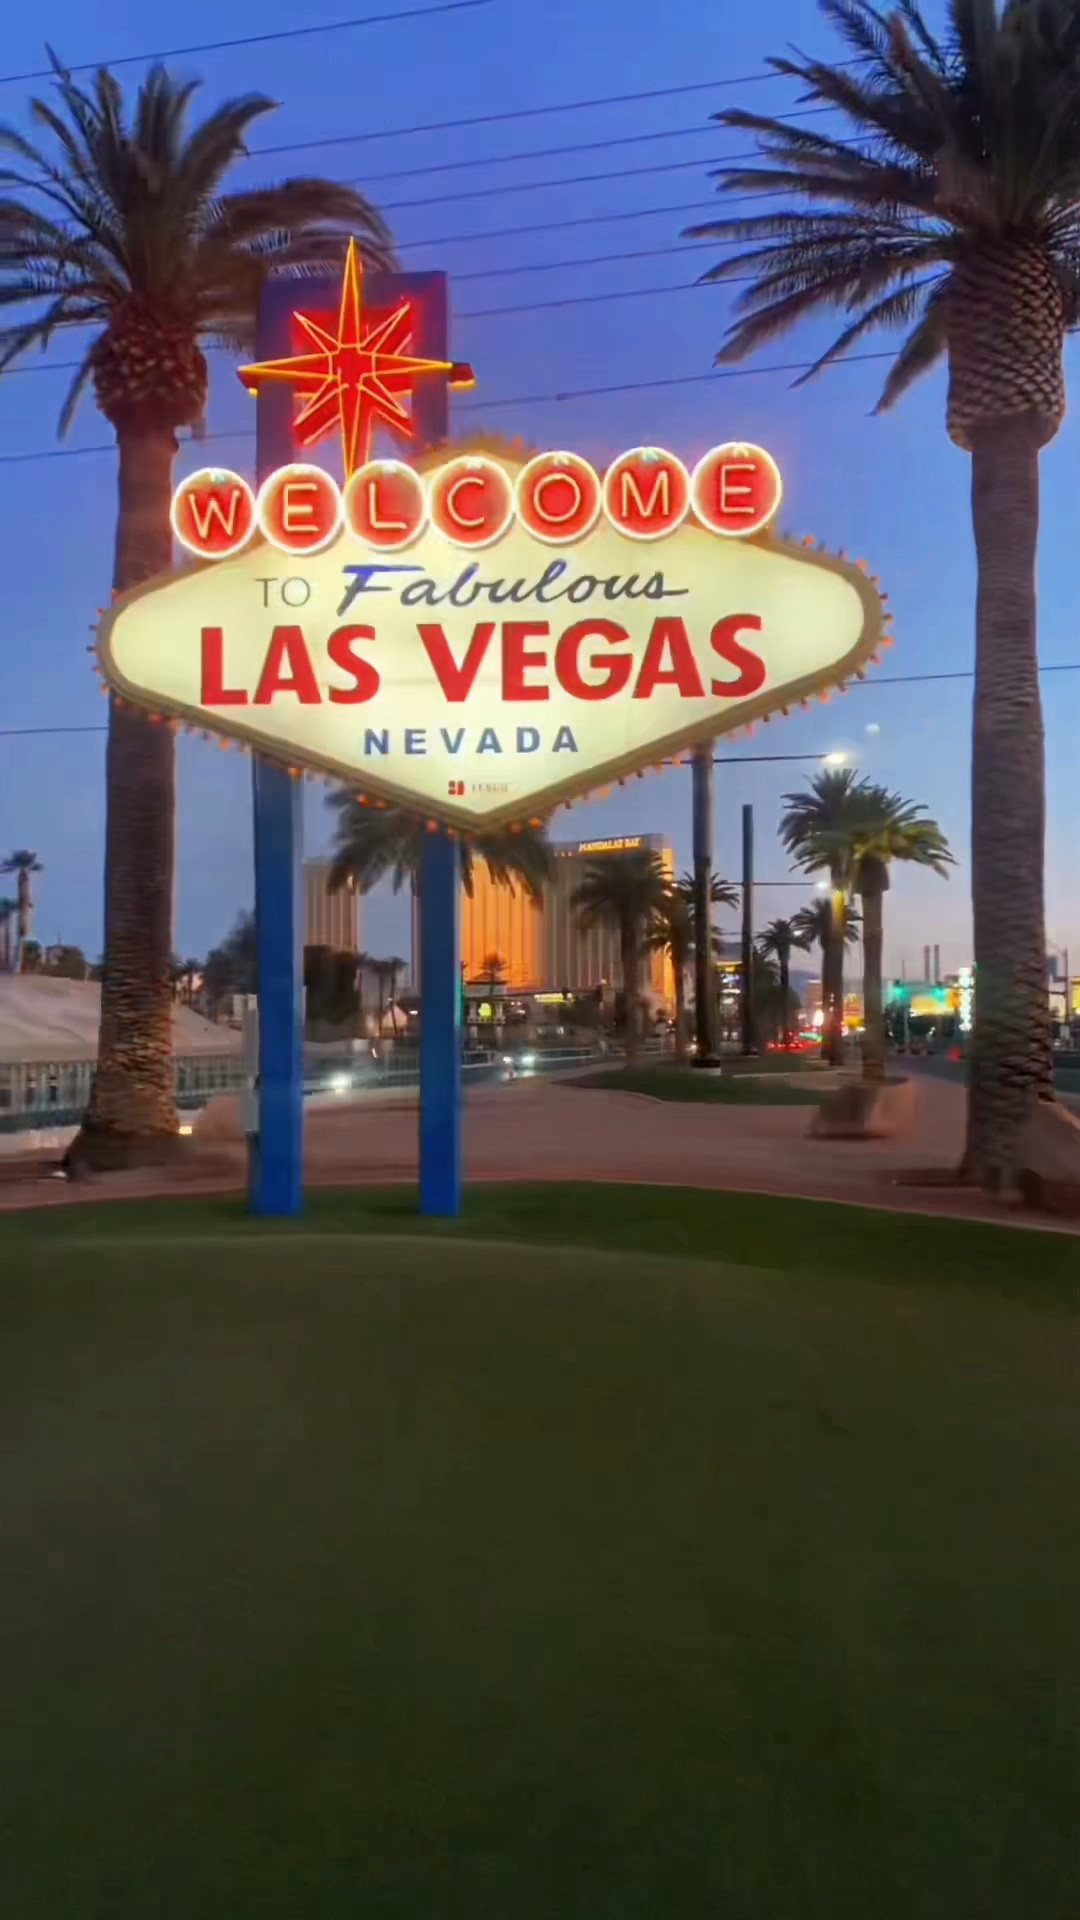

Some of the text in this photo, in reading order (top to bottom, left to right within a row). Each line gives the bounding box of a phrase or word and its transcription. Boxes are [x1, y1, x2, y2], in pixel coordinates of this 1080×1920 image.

[188, 463, 757, 540] WELCOME
[255, 558, 689, 617] TO Fabulous
[200, 613, 767, 705] LAS VEGAS
[364, 725, 579, 756] NEVADA
